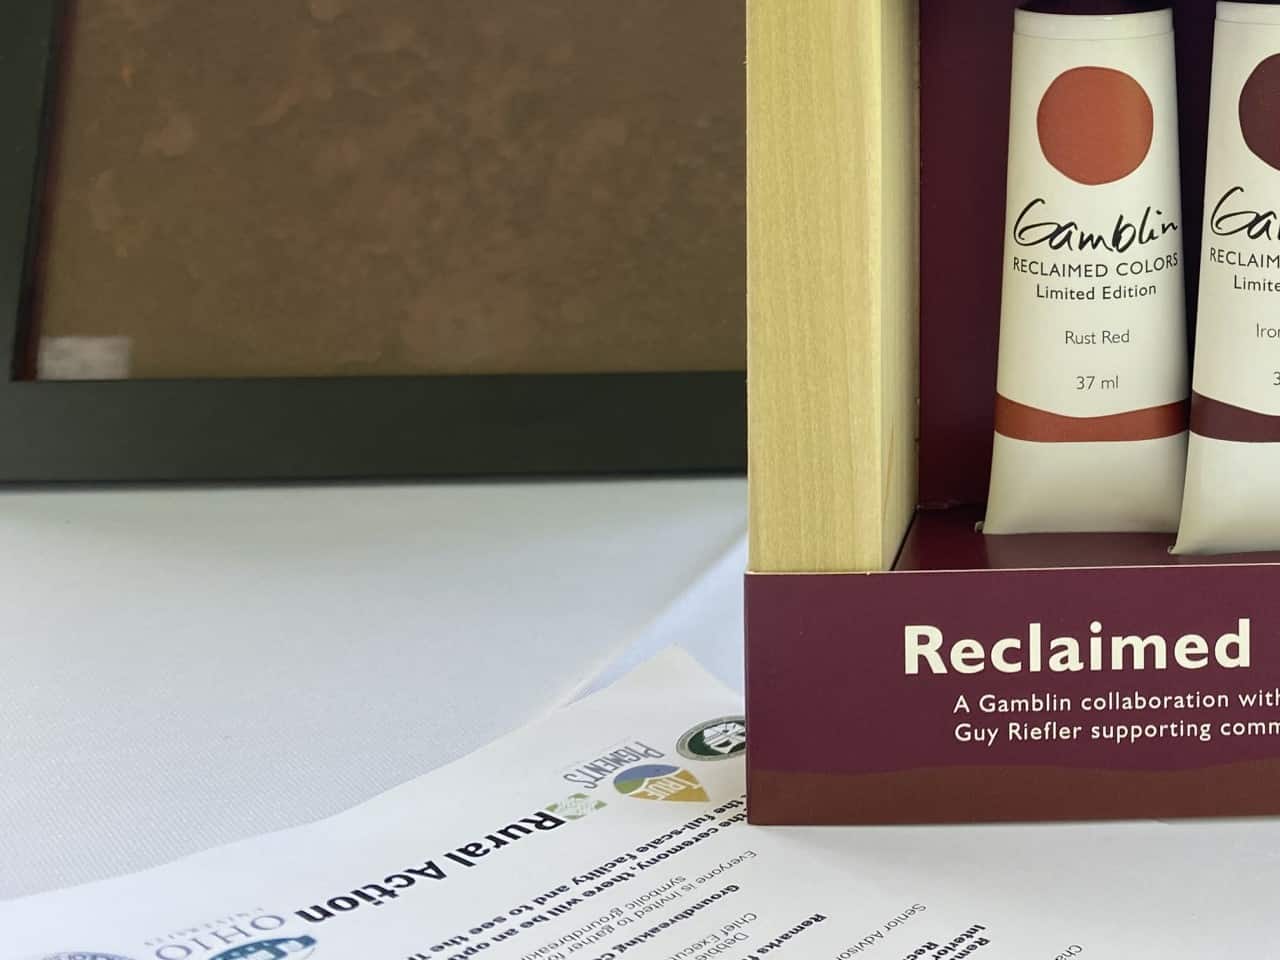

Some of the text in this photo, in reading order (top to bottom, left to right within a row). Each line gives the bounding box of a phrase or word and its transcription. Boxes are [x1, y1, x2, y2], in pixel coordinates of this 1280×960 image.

[1013, 198, 1178, 253] Gamblin
[1013, 252, 1178, 278] RECLAIMED COLORS
[1036, 283, 1157, 300] Limited Edition
[1065, 329, 1130, 345] Rust Red
[1076, 376, 1119, 390] 37 ml
[904, 617, 1251, 675] Reclaimed
[953, 695, 970, 714] A
[979, 693, 1071, 713] Gamblin
[1081, 690, 1229, 711] collaboration
[954, 723, 999, 746] Guy
[1008, 721, 1082, 741] Riefler
[1090, 718, 1211, 744] supporting
[563, 742, 664, 789] PIGMENTS
[645, 776, 699, 799] TRUE
[630, 827, 719, 870] ceremony,
[294, 811, 566, 924] Rural Action
[429, 799, 744, 953] the full-scale facility and to see the
[695, 850, 757, 884] Everyone
[582, 871, 636, 898] there
[624, 876, 686, 910] symbolic
[680, 883, 696, 893] is
[545, 897, 584, 917] will
[634, 889, 682, 919] invited
[883, 902, 926, 933] Senior
[519, 914, 550, 929] be
[612, 885, 739, 954] Groundbreaking
[617, 916, 634, 928] to
[720, 912, 757, 938] Chief
[156, 915, 285, 960] OHIO
[490, 928, 519, 942] an
[567, 925, 616, 954] gather
[757, 913, 827, 955] Remarks
